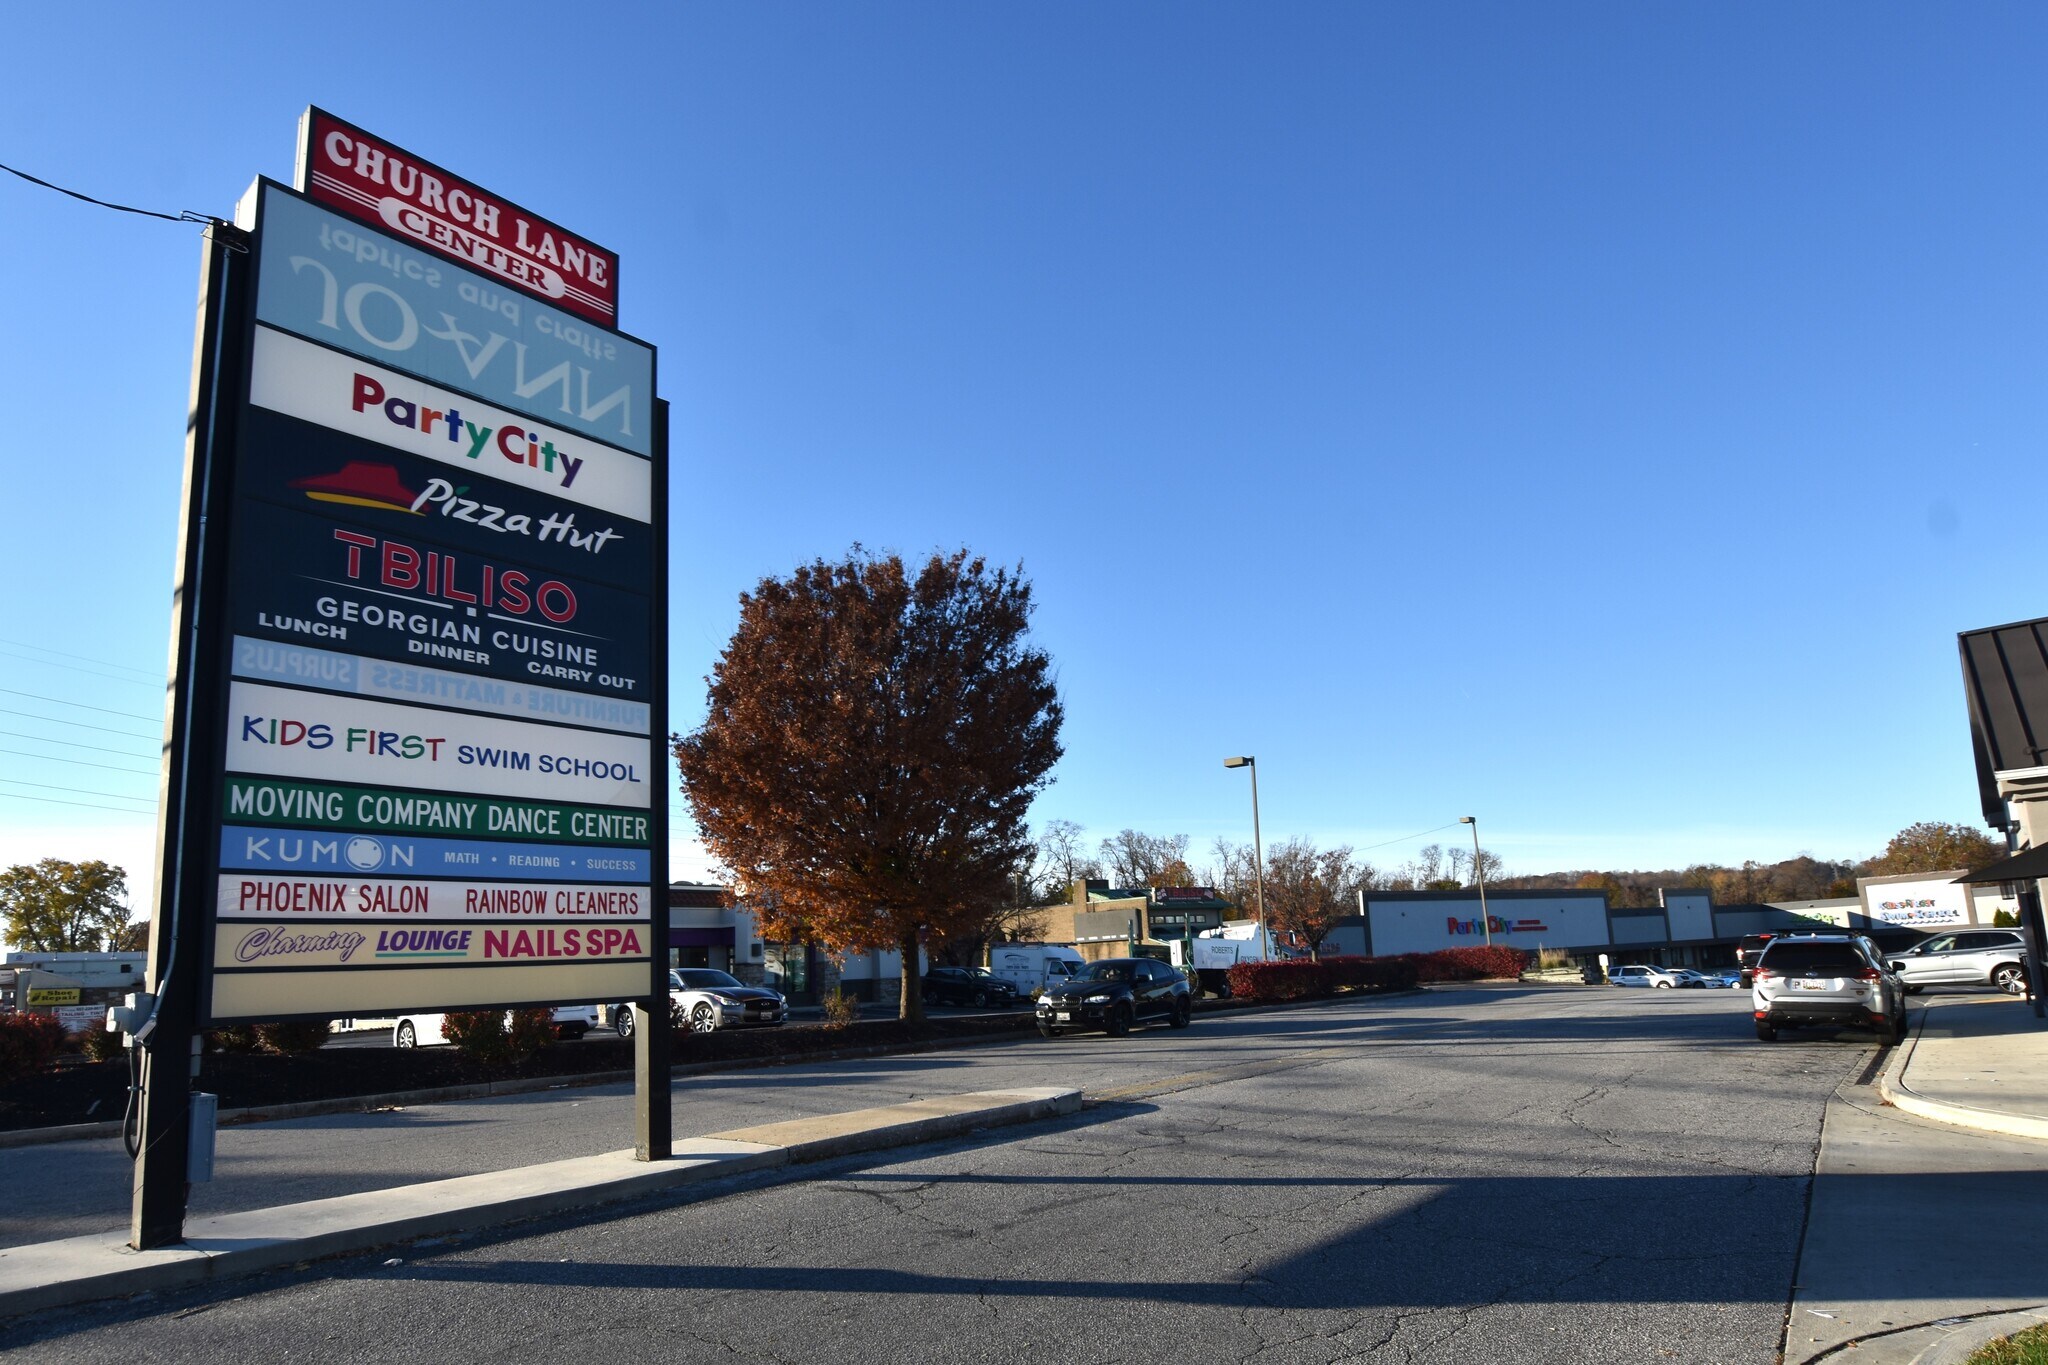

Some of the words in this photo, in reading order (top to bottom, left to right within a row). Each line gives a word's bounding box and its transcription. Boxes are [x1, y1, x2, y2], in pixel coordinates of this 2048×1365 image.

[325, 131, 500, 237] CHURCH
[516, 218, 608, 288] LANE
[398, 209, 549, 288] CENTER
[411, 477, 531, 535] Pizza
[538, 513, 624, 554] Hut
[334, 528, 578, 623] TBILISO
[259, 612, 347, 640] LUNCH
[316, 596, 480, 645] GEORGIAN
[492, 630, 597, 666] CUISINE
[408, 639, 490, 665] DINNER
[527, 661, 592, 684] CARRY
[598, 673, 636, 691] OUT
[242, 715, 334, 750] KIDS
[346, 727, 446, 762] FIRST
[457, 745, 531, 772] SWIM
[538, 754, 641, 783] SCHOOL
[230, 784, 344, 823] MOVING
[357, 794, 478, 830] COMPANY
[488, 806, 561, 836] DANCE
[571, 812, 648, 841] CENTER
[444, 851, 480, 865] MATH
[508, 855, 560, 868] READING
[587, 859, 636, 871] SUCCESS
[239, 881, 348, 913] PHOENIX
[358, 885, 429, 914] SALON
[466, 888, 548, 915] RAINBOW
[555, 890, 639, 916] CLEANERS
[235, 927, 366, 963] Charming
[376, 930, 472, 952] LOUNGE
[484, 928, 582, 959] NAILS
[586, 928, 643, 955] SPA
[1211, 946, 1233, 955] ROBERTS
